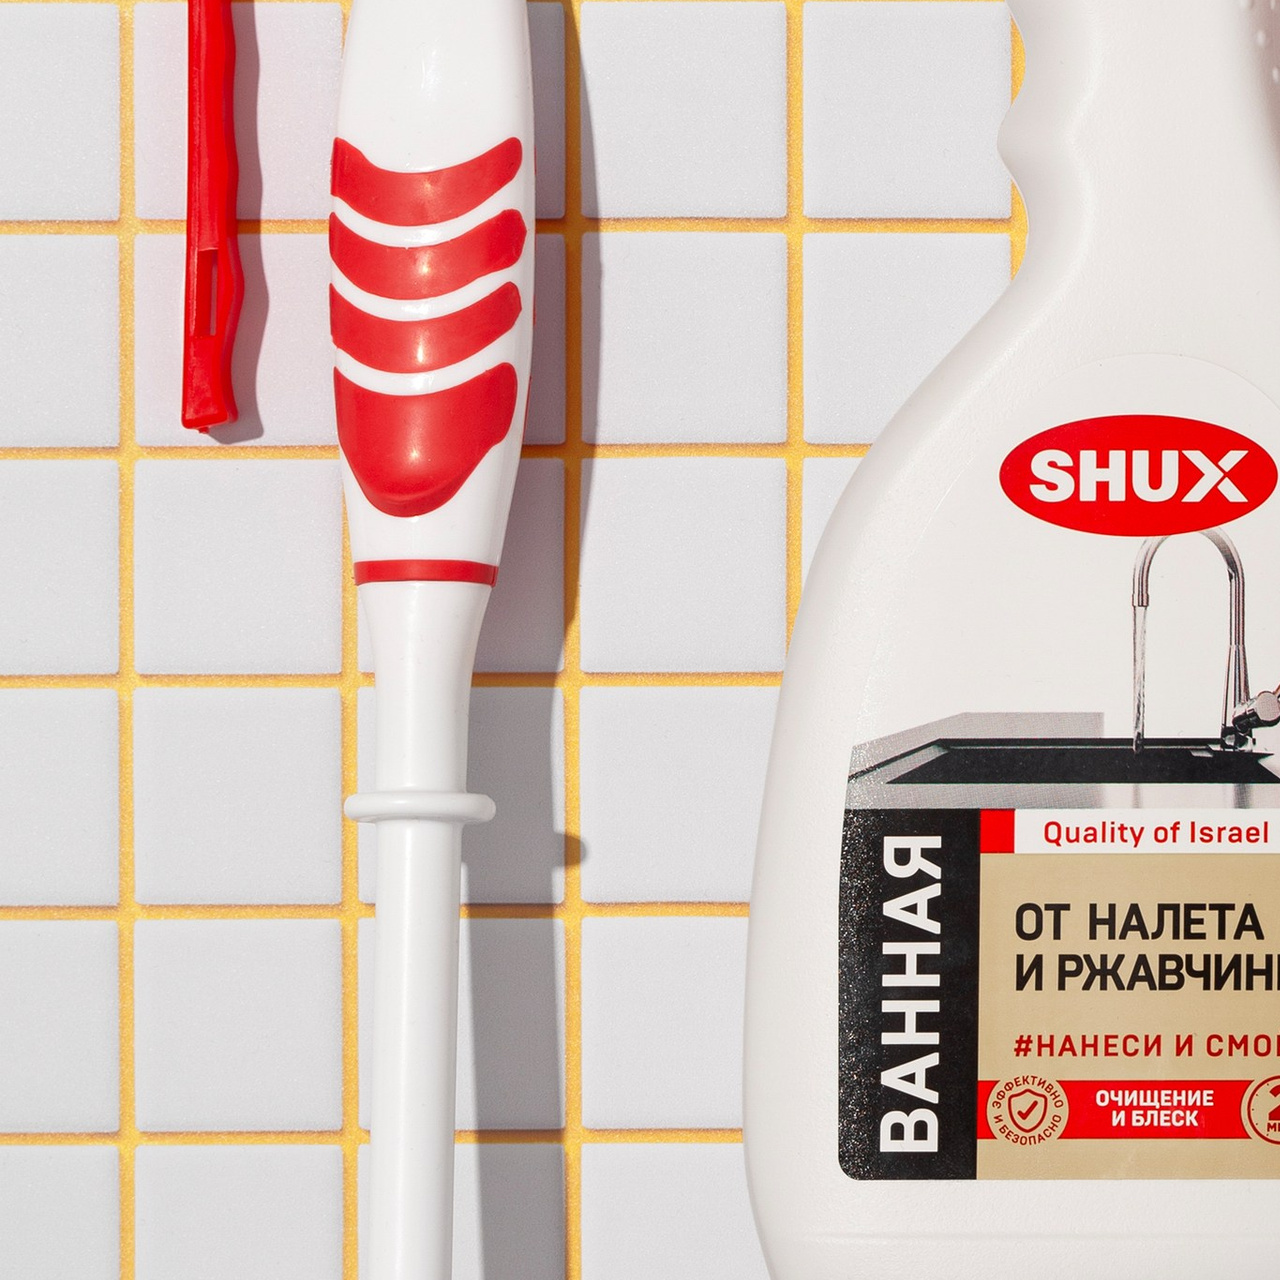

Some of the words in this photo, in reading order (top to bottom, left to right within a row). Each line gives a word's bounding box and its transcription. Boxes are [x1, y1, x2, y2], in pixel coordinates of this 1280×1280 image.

[1029, 449, 1249, 503] SHUX
[1043, 820, 1145, 848] Quality
[1153, 821, 1181, 843] of
[1190, 821, 1269, 844] Israel
[1015, 902, 1071, 941] ОТ
[1088, 902, 1265, 941] НАЛЕТА
[1015, 953, 1044, 991] И
[879, 834, 942, 1154] ВАННАЯ
[1013, 1034, 1162, 1058] #НАНЕСИ
[1175, 1034, 1194, 1058] И
[992, 1075, 1064, 1109] ЭФФЕКТИВНО
[1095, 1089, 1214, 1109] ОЧИЩЕНИЕ
[993, 1114, 1003, 1124] И
[998, 1114, 1062, 1146] БЕЗОПАСНО
[1111, 1110, 1126, 1127] И
[1131, 1110, 1199, 1127] БЛЕСК
